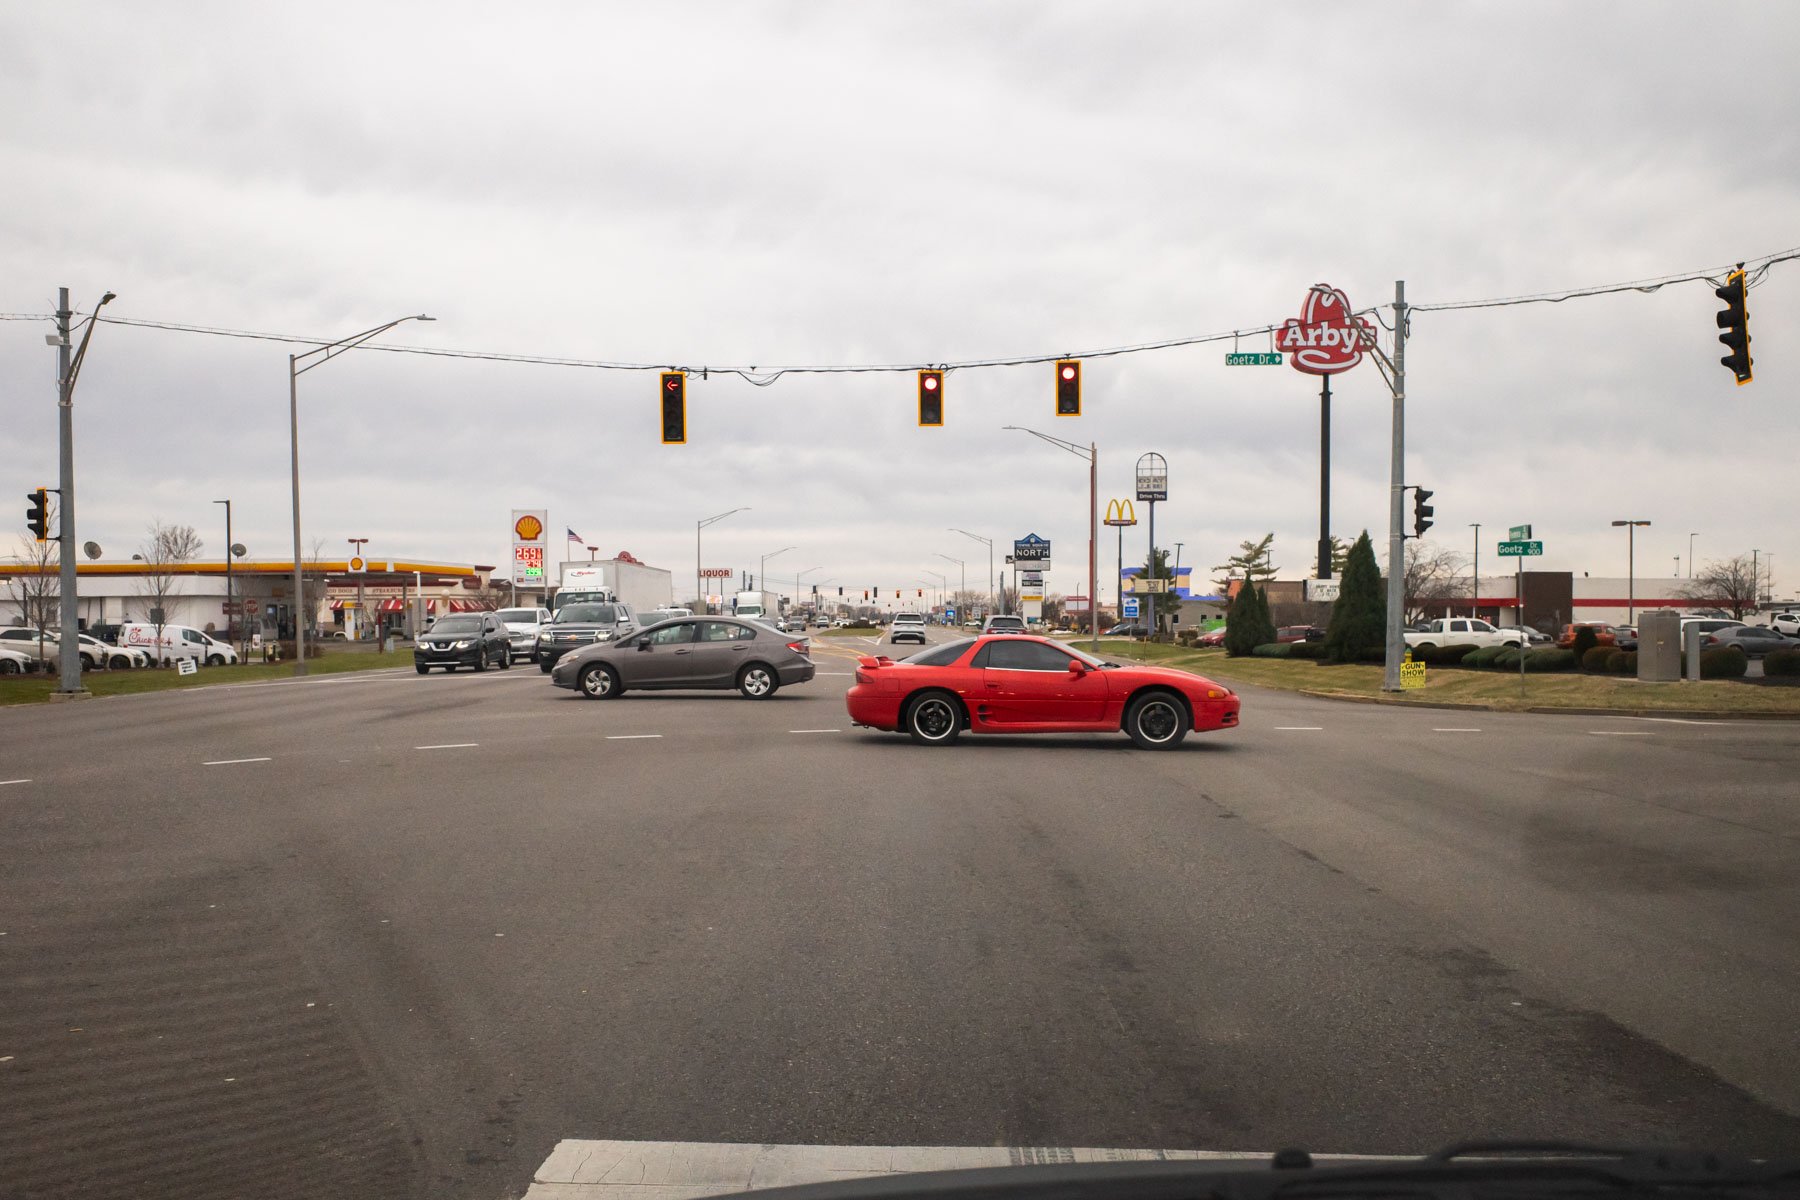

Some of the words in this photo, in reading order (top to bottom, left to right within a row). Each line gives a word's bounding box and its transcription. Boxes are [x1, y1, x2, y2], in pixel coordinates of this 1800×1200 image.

[1283, 322, 1376, 354] Arbys
[1226, 354, 1254, 365] Goetz
[1258, 354, 1273, 365] Dr.
[1499, 545, 1523, 553] Goetz
[699, 569, 730, 577] LIQUOR
[128, 628, 173, 646] Chick-fl-A
[1405, 662, 1421, 670] GUN
[1402, 669, 1425, 677] SHOW
